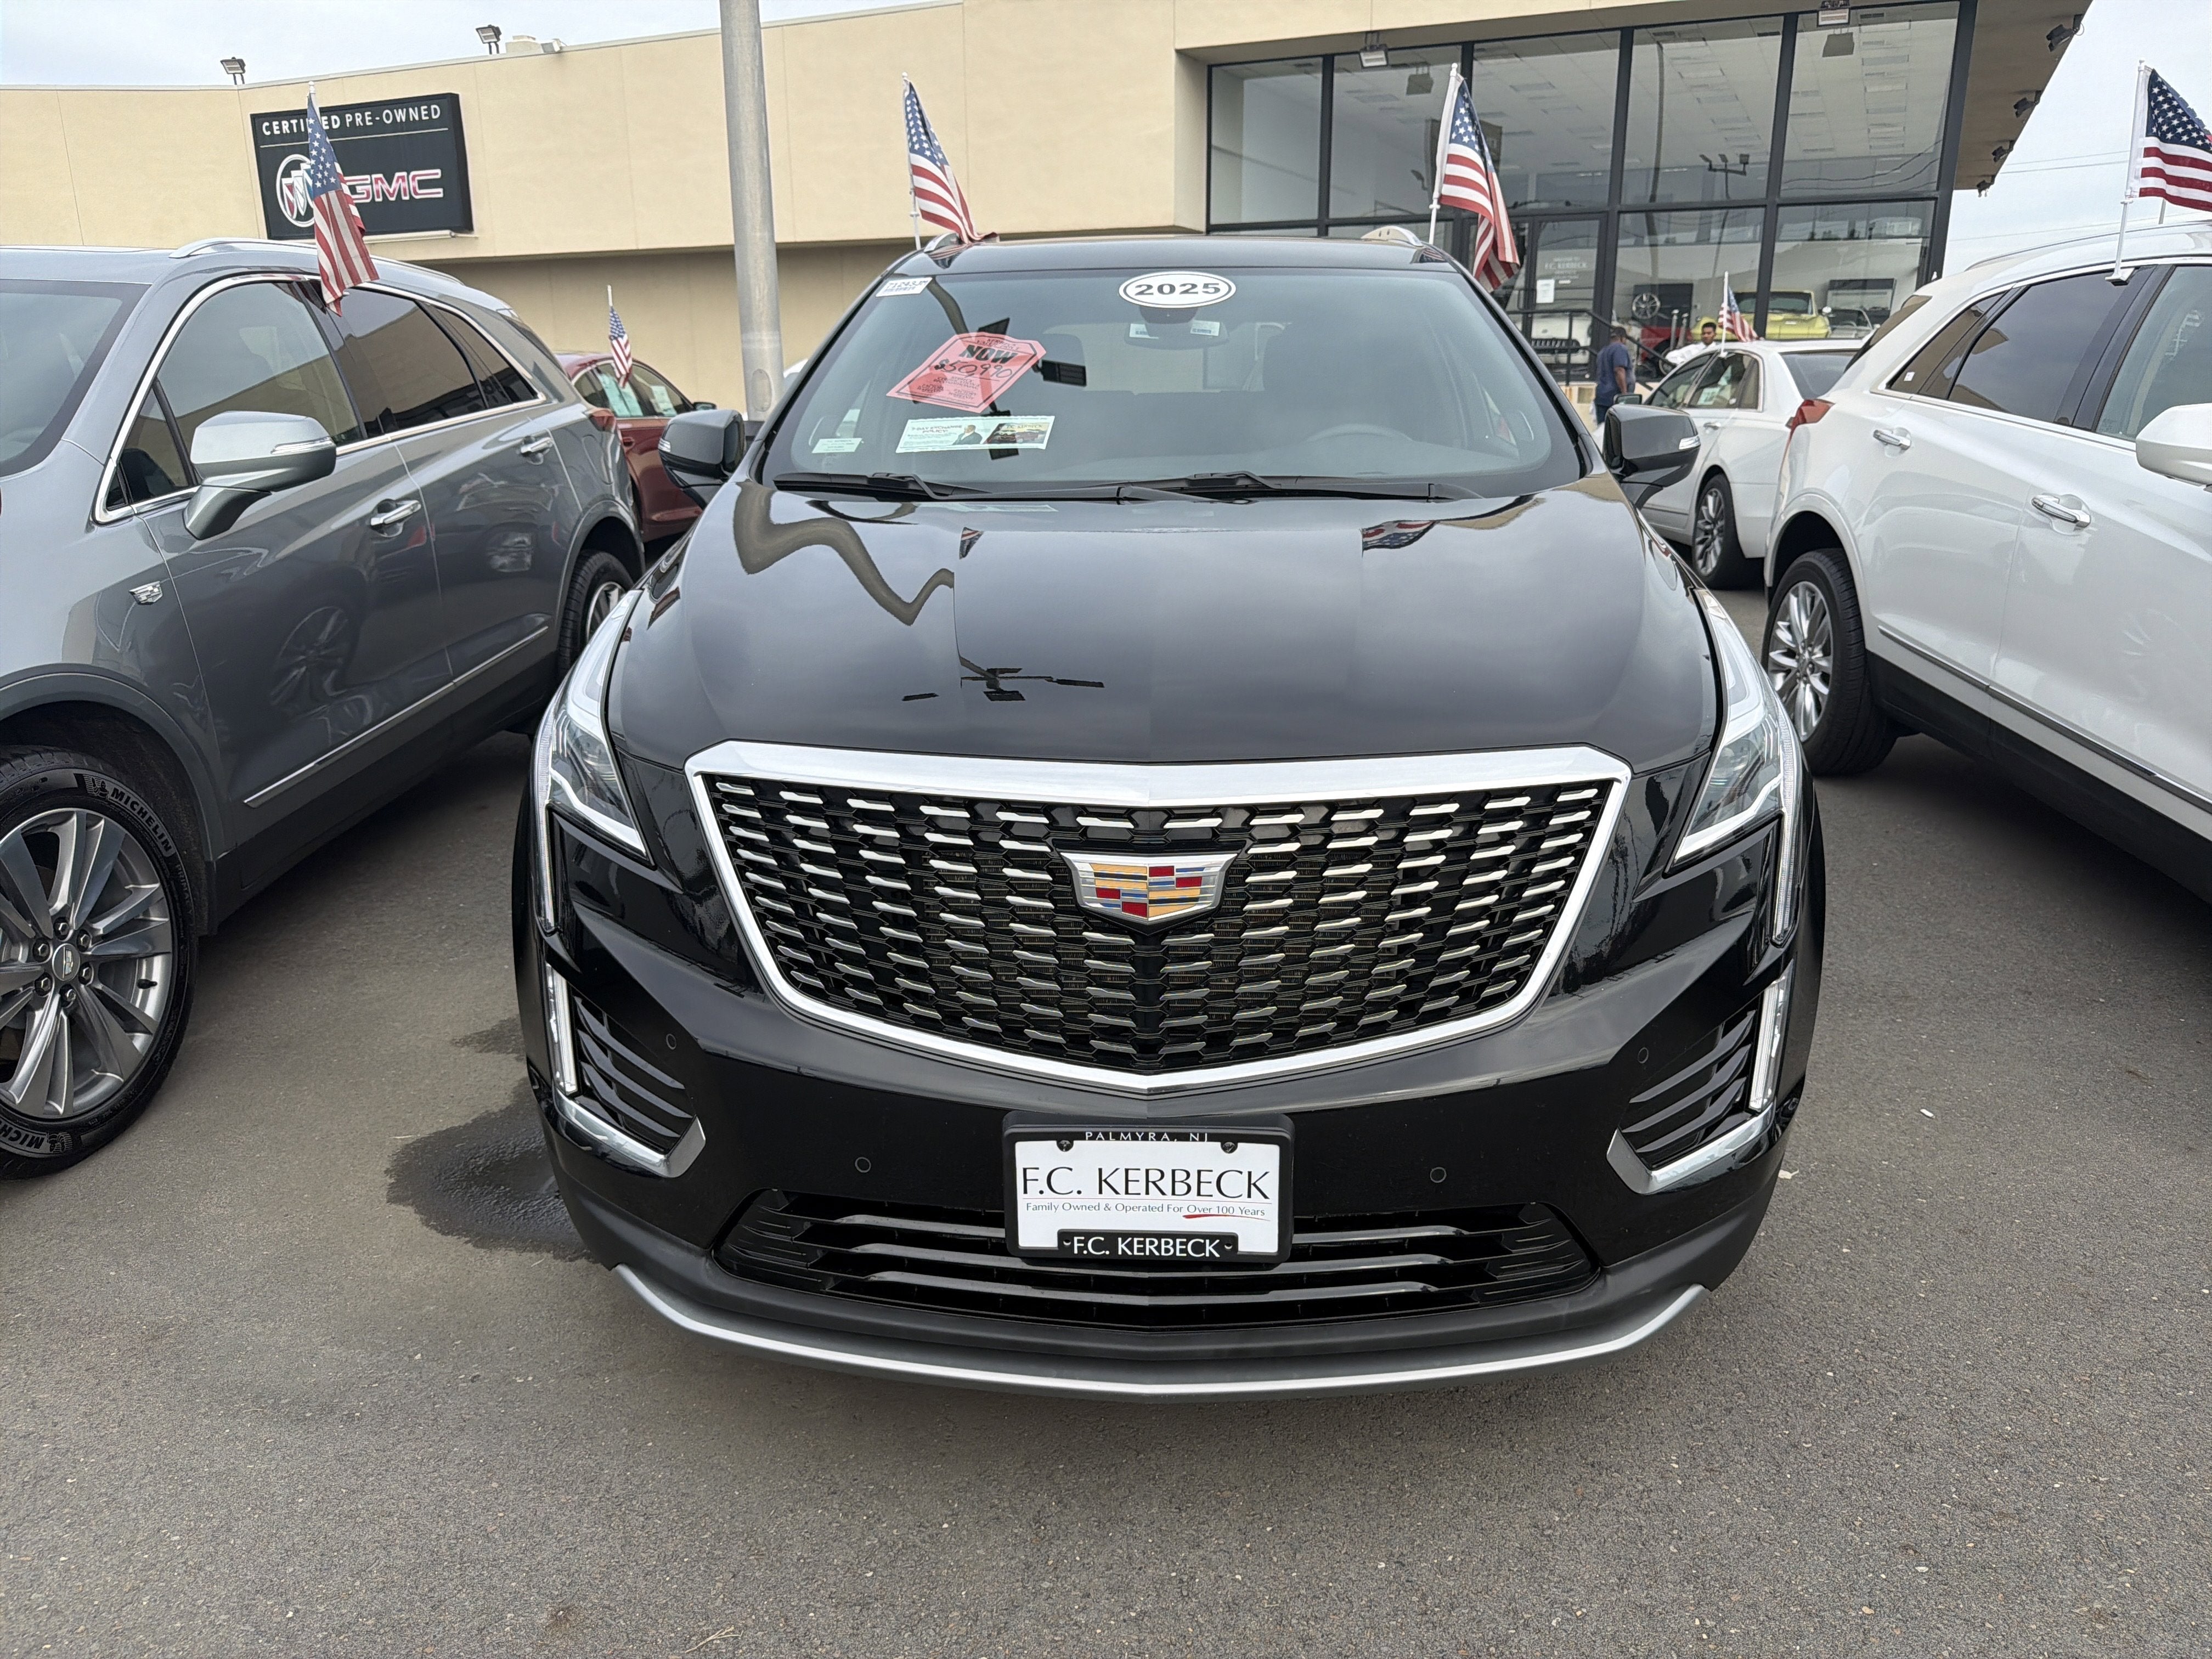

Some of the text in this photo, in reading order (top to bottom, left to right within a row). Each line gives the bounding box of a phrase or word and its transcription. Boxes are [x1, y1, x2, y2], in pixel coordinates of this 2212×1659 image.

[262, 104, 441, 136] CERTIED PRE-OWNED
[343, 169, 444, 204] GMC
[1134, 283, 1221, 296] 2025
[958, 344, 1019, 364] NOW
[934, 358, 1013, 379] $50,990
[110, 787, 173, 853] MICHELIN
[0, 1120, 45, 1149] MICH
[1085, 1132, 1177, 1142] PALMYRA,
[1022, 1166, 1271, 1200] F.C. KERBECK
[1026, 1202, 1265, 1216] Family Owned & Operated For Over 100 Years
[1073, 1236, 1221, 1258] F.C. KERBECK
